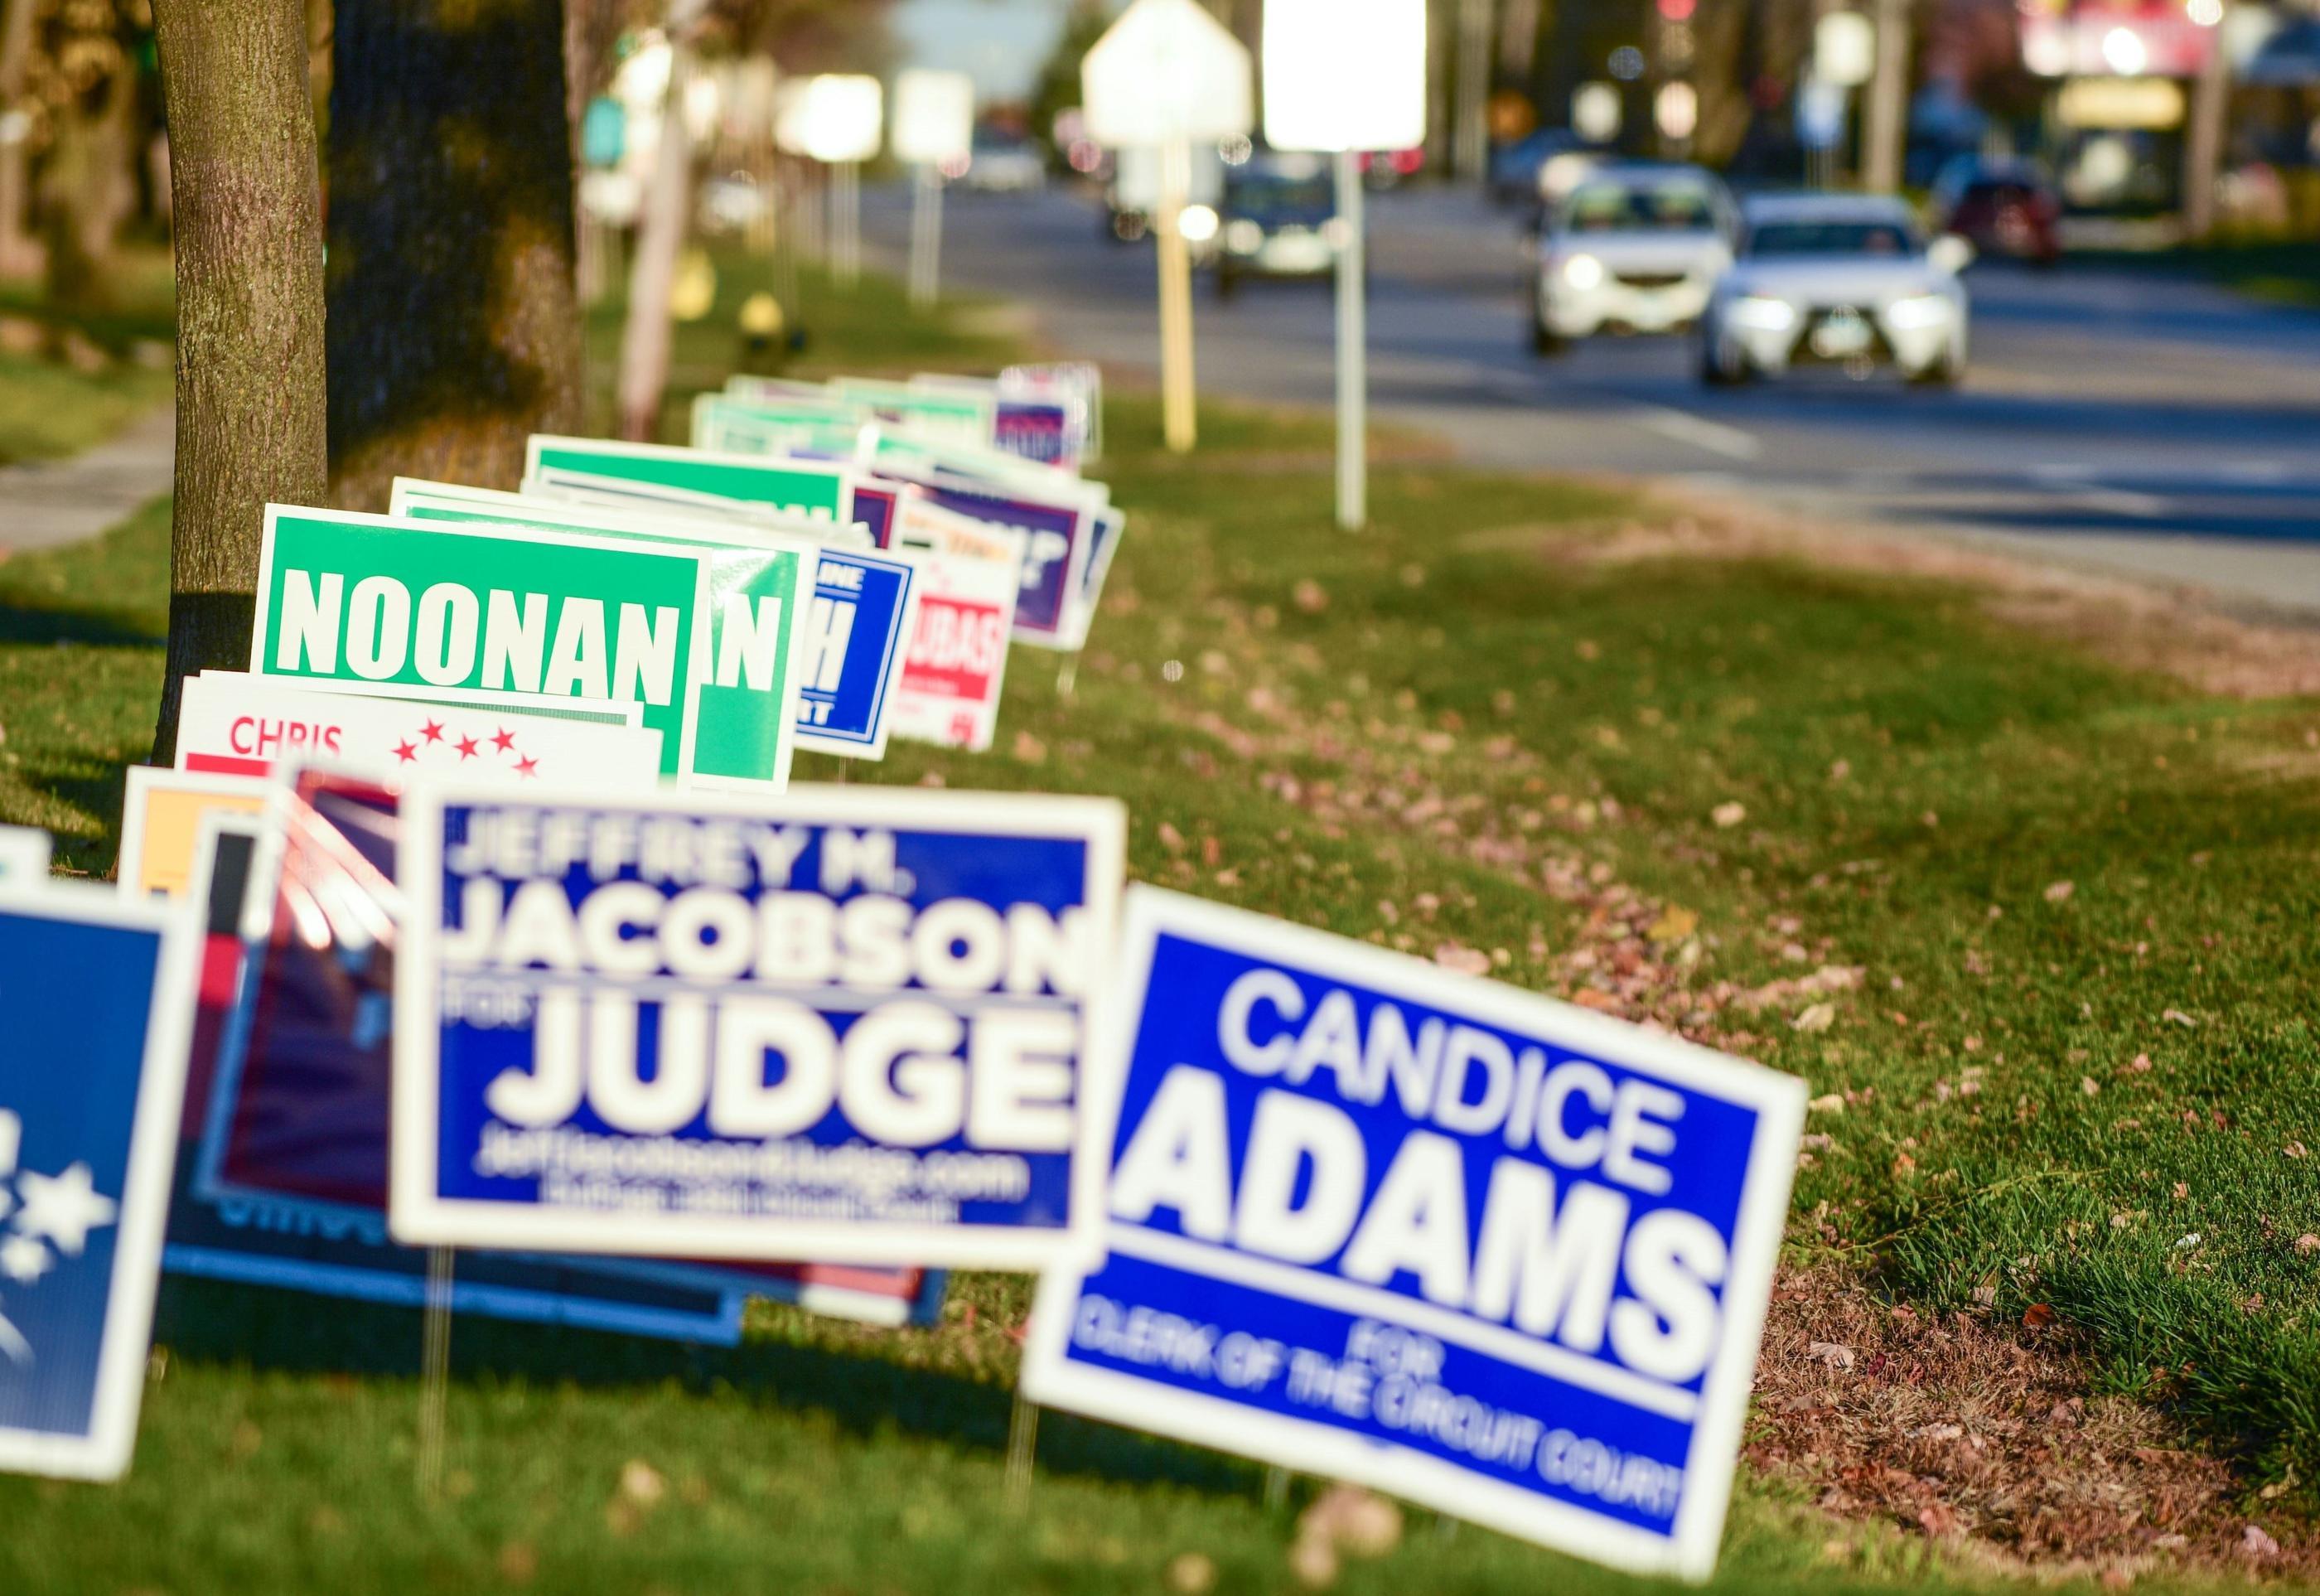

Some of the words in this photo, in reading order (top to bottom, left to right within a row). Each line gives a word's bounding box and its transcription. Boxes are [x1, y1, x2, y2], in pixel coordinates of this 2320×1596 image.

[276, 568, 680, 706] NOONAN
[230, 716, 342, 757] CHRIS
[448, 808, 809, 891] JEFFREY
[819, 828, 916, 897] M.
[442, 875, 1085, 995] JACOBSON
[441, 976, 536, 1029] FOR
[486, 994, 1079, 1152] JUDGE
[1217, 968, 1686, 1197] CANDICE
[1109, 1062, 1730, 1384] ADAMS
[1072, 1293, 1221, 1381] CLERK
[1213, 1330, 1289, 1393] OF
[1286, 1345, 1376, 1420] THE
[1372, 1372, 1547, 1473] CIRCUIT
[1536, 1428, 1684, 1521] COURT
[1345, 1316, 1447, 1382] FOR
